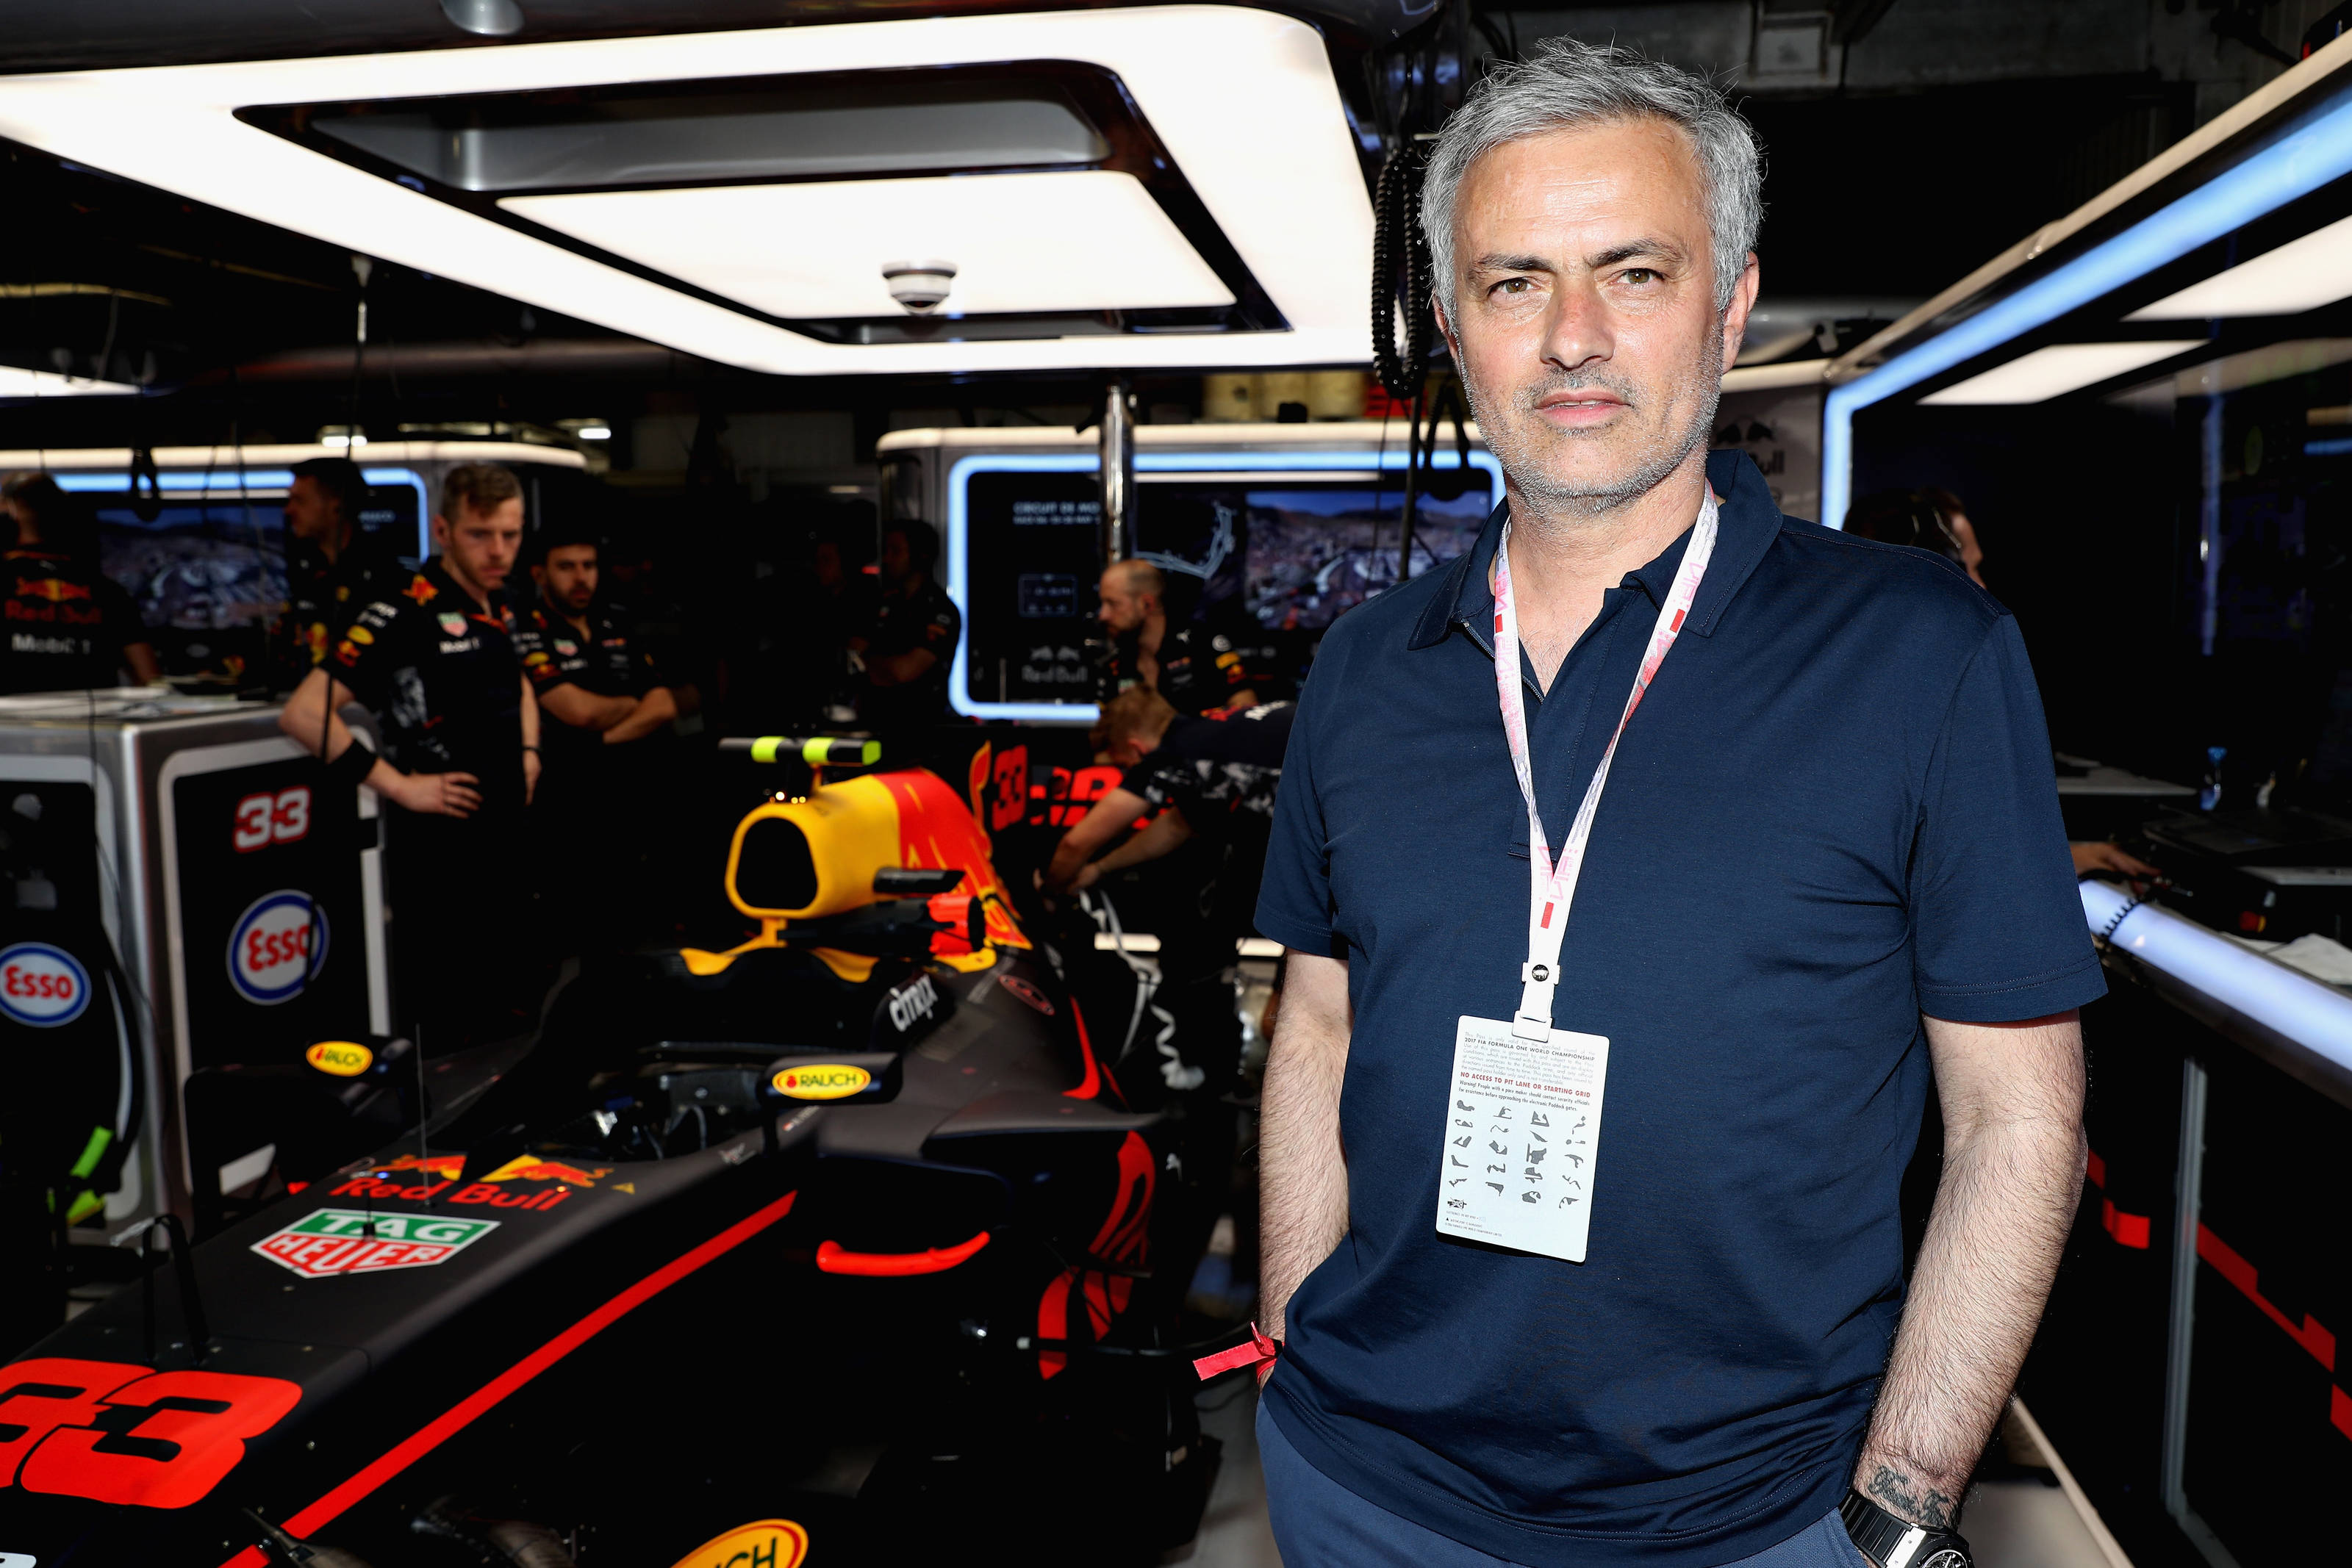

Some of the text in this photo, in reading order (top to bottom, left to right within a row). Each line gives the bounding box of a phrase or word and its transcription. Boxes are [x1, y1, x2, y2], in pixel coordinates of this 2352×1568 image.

[1750, 452, 1785, 475] ull
[4, 599, 56, 622] Red
[1022, 664, 1089, 683] Red Bull
[992, 744, 1028, 832] 33
[234, 786, 310, 852] 33
[4, 965, 74, 1000] Esso
[1488, 1040, 1513, 1049] FORMULA
[1551, 1051, 1594, 1062] CHAMPIONSHIP
[799, 1073, 857, 1088] RAUCH
[1471, 1073, 1492, 1082] ACCESS
[1544, 1085, 1572, 1094] STARTING
[1498, 1093, 1521, 1102] approaching
[329, 1176, 572, 1211] Red Bull
[319, 1214, 474, 1242] TAG
[269, 1234, 444, 1274] HEUER
[0, 1357, 303, 1508] 33
